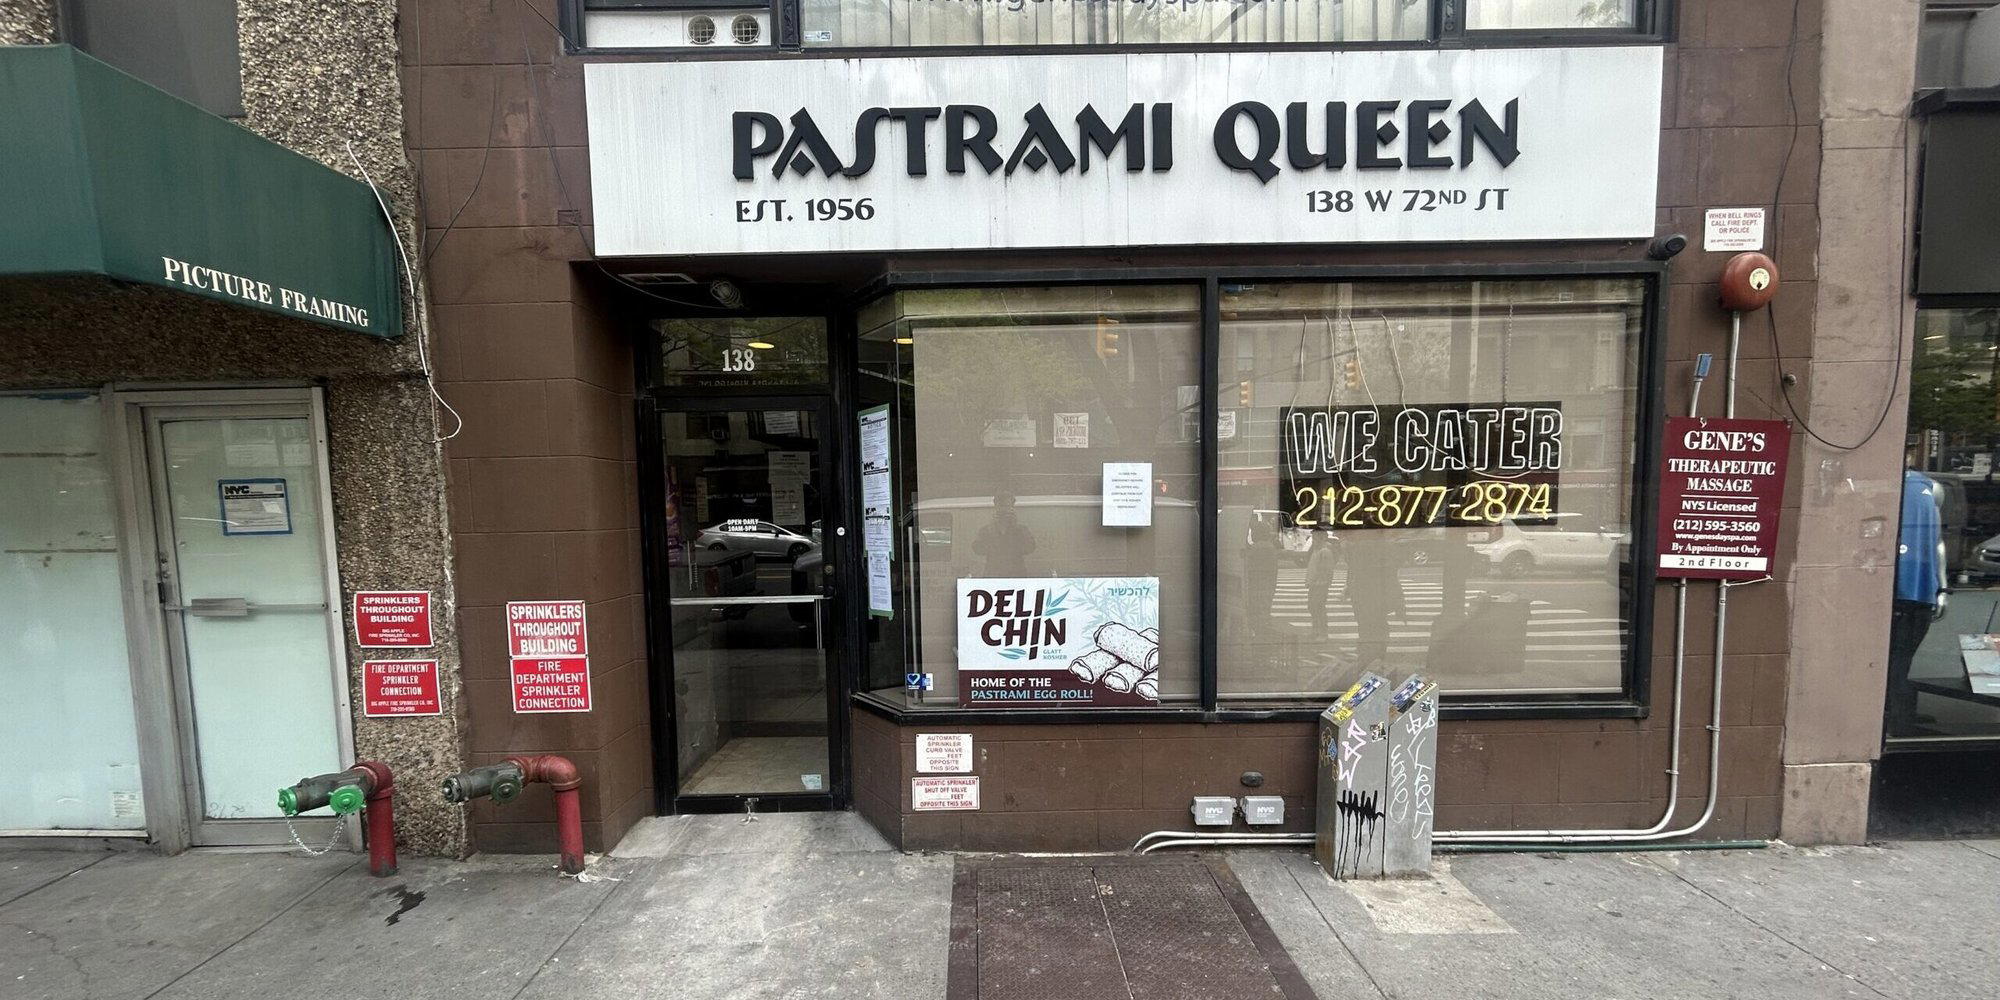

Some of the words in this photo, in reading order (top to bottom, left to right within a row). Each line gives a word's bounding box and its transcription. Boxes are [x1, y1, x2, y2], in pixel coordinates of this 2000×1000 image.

[732, 102, 1173, 181] PASTRAMI
[1213, 97, 1521, 184] QUEEN
[1306, 189, 1353, 212] 138
[1364, 190, 1393, 212] W
[1403, 188, 1467, 212] 72ND
[1474, 188, 1510, 211] ST
[736, 200, 793, 222] EST.
[805, 198, 875, 221] 1956
[162, 256, 273, 305] PICTURE
[279, 287, 369, 327] FRAMING
[722, 349, 755, 372] 138
[1292, 411, 1377, 474] WE
[1393, 407, 1563, 474] CATER
[1684, 430, 1766, 452] GENE'S
[1669, 458, 1776, 475] THERAPEUTIC
[224, 485, 250, 495] NYC
[1686, 477, 1753, 492] MASSAGE
[1295, 483, 1552, 526] 212-877-2874
[1682, 500, 1705, 511] NYS
[1706, 501, 1757, 512] Licensed
[1673, 518, 1703, 531] (212)
[1704, 519, 1761, 532] 595-3560
[1675, 532, 1757, 541] www.genesdayspa.com
[1672, 543, 1684, 554] By
[1685, 543, 1739, 555] Appointment
[1741, 545, 1762, 556] Only
[1107, 586, 1150, 597] להכשיר
[966, 588, 1046, 618] DELI
[360, 606, 424, 614] THROUGHOUT
[510, 604, 582, 619] SPRINKLERS
[370, 615, 415, 623] BUILDING
[513, 622, 581, 636] THROUGHOUT
[980, 618, 1067, 660] CHIN
[520, 639, 577, 653] BUILDING
[371, 665, 386, 673] FIRE
[388, 664, 429, 673] DEPARTMENT
[538, 661, 562, 671] FIRE
[382, 676, 419, 685] SPRINKLER
[516, 673, 585, 684] DEPARTMENT
[971, 678, 1006, 688] HOME
[1010, 678, 1026, 687] OF
[1029, 677, 1052, 687] THE
[380, 687, 422, 696] CONNECTION
[522, 685, 581, 696] SPRINKLER
[971, 690, 1030, 700] PASTRAMI
[1034, 690, 1057, 699] EGG
[1060, 689, 1094, 699] ROLL!
[519, 698, 585, 708] CONNECTION
